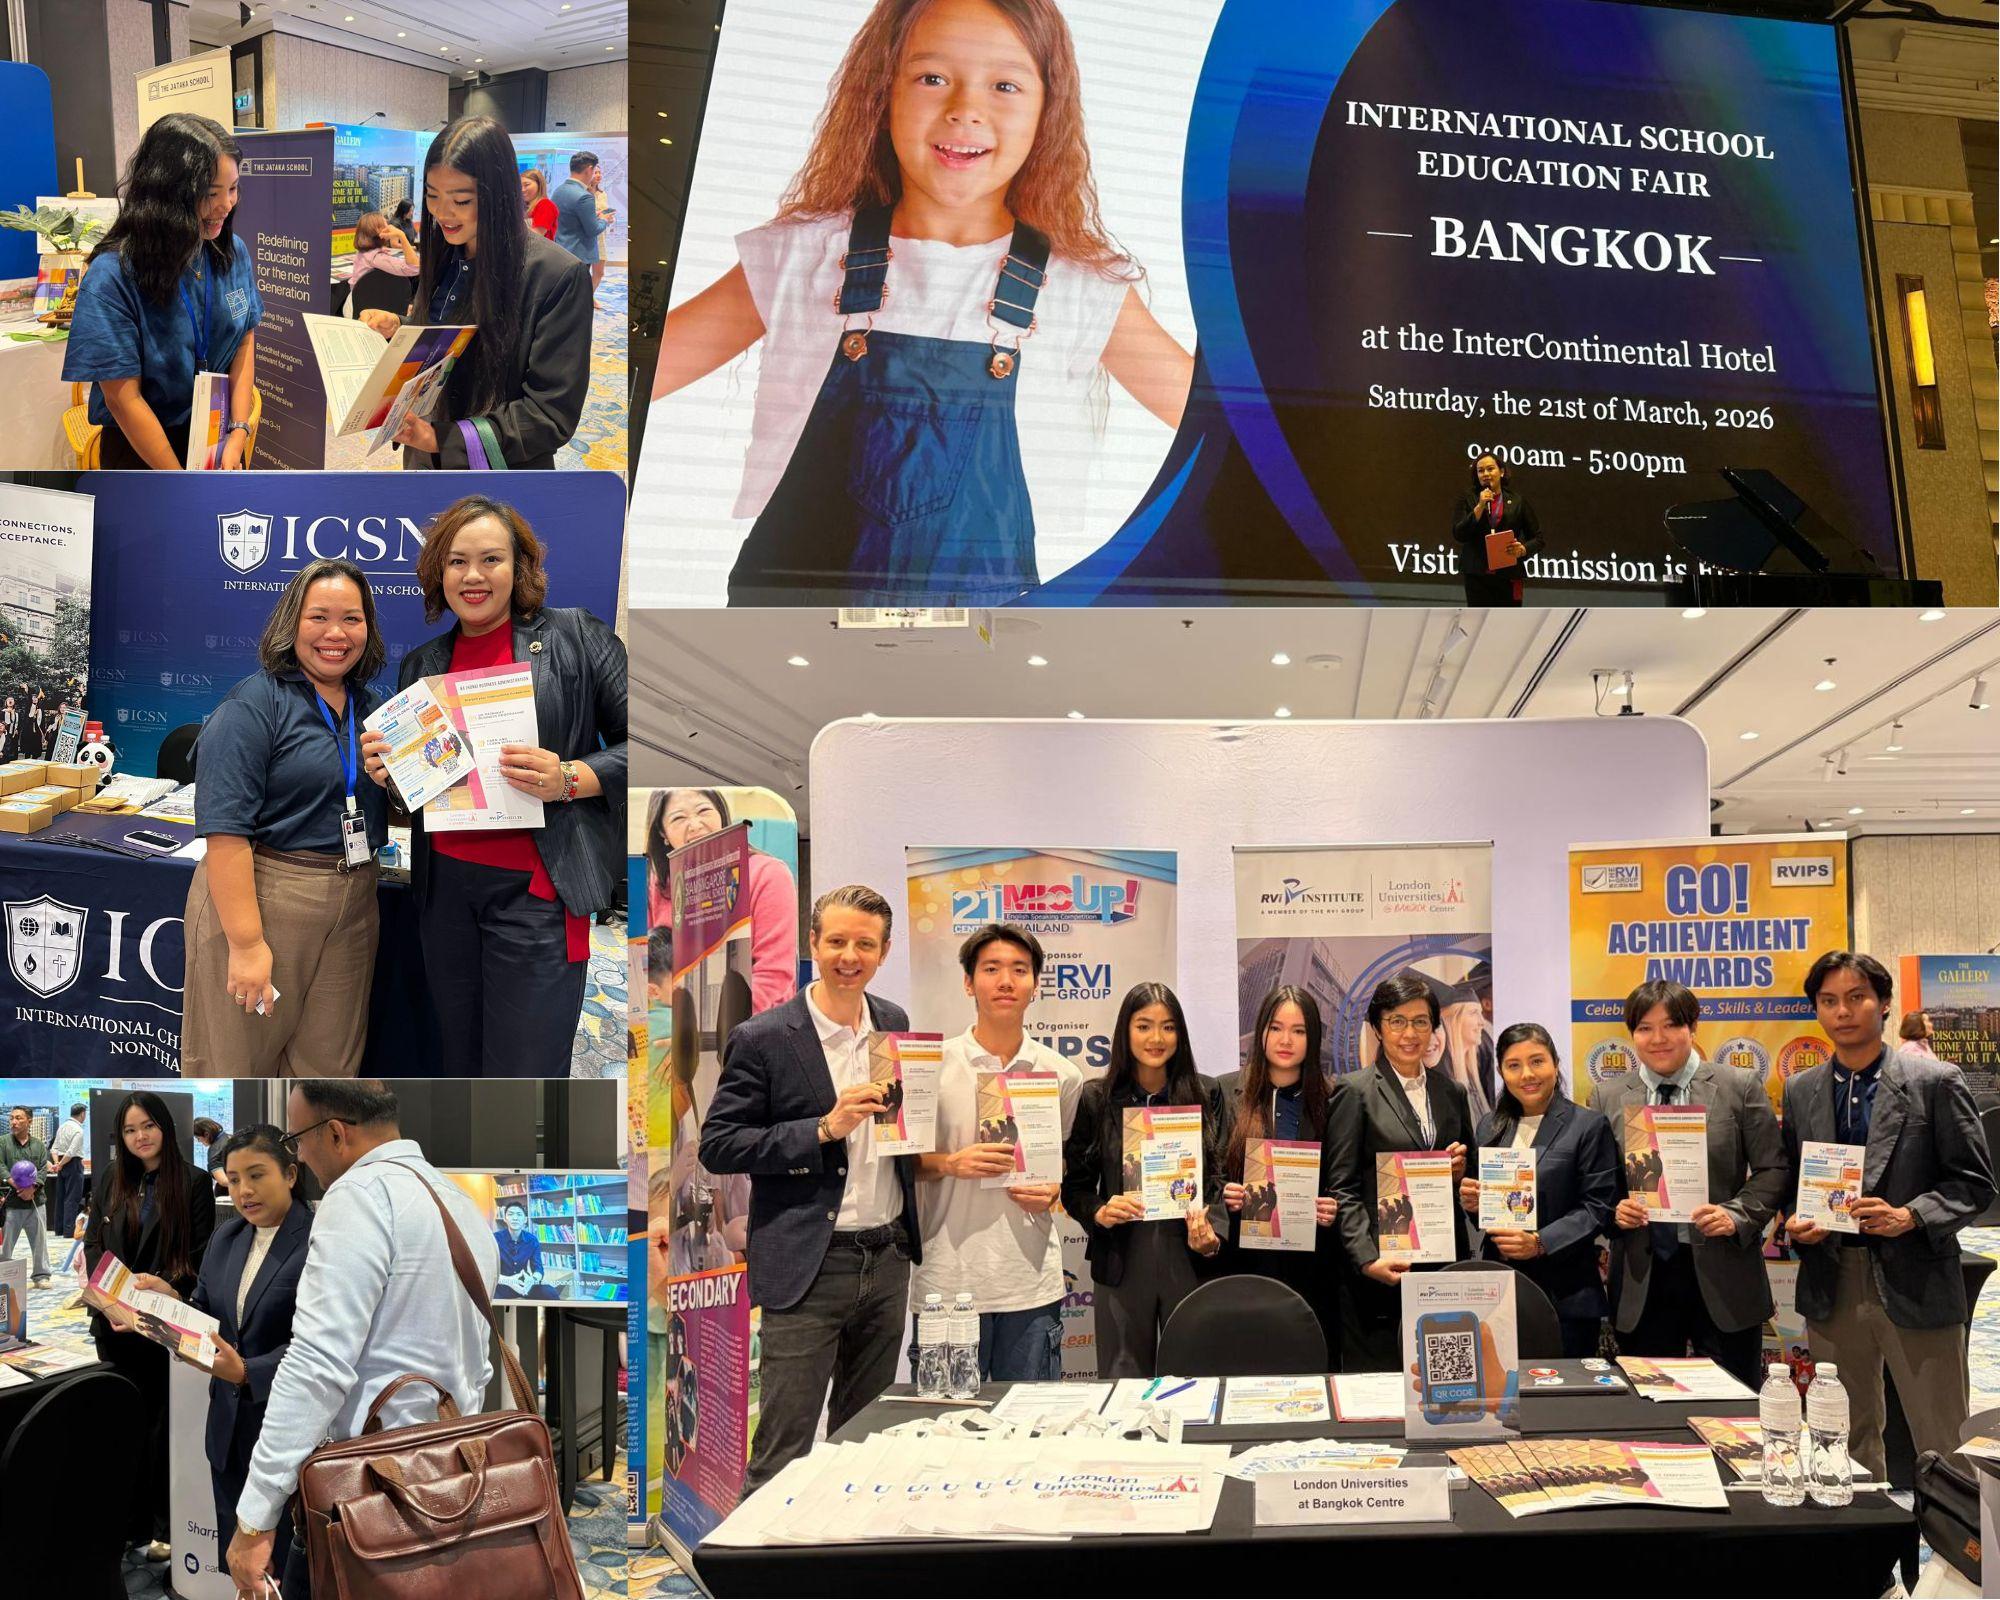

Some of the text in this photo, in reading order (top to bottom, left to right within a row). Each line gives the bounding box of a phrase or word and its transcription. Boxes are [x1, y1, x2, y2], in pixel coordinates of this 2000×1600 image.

[161, 75, 210, 93] THE JATAKA SCHOOL
[1346, 101, 1775, 159] INTERNATIONAL SCHOOL
[254, 163, 308, 172] THE JATAKA SCHOOL
[1417, 151, 1711, 197] EDUCATION FAIR
[257, 232, 309, 254] Redefining
[1430, 216, 1716, 275] BANGKOK
[257, 248, 305, 267] Education
[257, 264, 310, 285] for the next
[257, 279, 310, 302] Generation
[256, 342, 304, 367] Buddhist wisdom,
[1362, 323, 1776, 373] at the InterContinental Hotel
[255, 354, 278, 367] relevant
[278, 361, 286, 369] for
[256, 376, 284, 394] Inquiry-led
[267, 390, 294, 408] immersive
[1368, 384, 1774, 430] Saturday, the 21st of March, 2026
[260, 416, 270, 426] ges
[255, 446, 277, 465] Opening
[1589, 450, 1687, 478] 5:00pm
[0, 519, 76, 535] ONNECTIONS,
[0, 532, 67, 546] CCEPTANCE.
[1388, 544, 1458, 574] Visit
[1524, 550, 1657, 582] dmission
[176, 673, 212, 686] ICSN
[131, 709, 168, 723] ICSN
[1615, 866, 1639, 878] RVI
[1776, 864, 1829, 878] RVIPS
[1389, 881, 1431, 891] London
[1665, 862, 1751, 917] GO!
[1302, 892, 1364, 904] INSTITUTE
[1379, 891, 1442, 904] Universities
[1429, 905, 1456, 913] Centre
[1031, 914, 1059, 922] Speaking
[954, 924, 981, 933] CENT
[1608, 918, 1812, 954] ACHIEVEMENT
[1644, 955, 1774, 989] AWARDS
[1958, 962, 1970, 970] THE
[1040, 964, 1056, 1000] THE
[1058, 964, 1111, 988] RVI
[1938, 970, 1990, 984] GALLERY
[1058, 988, 1111, 1000] GROUP
[1717, 1002, 1750, 1014] Skills
[1754, 1002, 1764, 1012] &
[16, 1006, 154, 1037] INTERNATIONAL
[1037, 1022, 1090, 1031] Organiser
[1932, 1030, 1989, 1041] DISCOVER A
[1933, 1042, 1998, 1052] HOME AT THE
[110, 1041, 181, 1073] NONTHA
[1603, 1054, 1626, 1069] GO!
[1730, 1053, 1754, 1067] GO!
[1967, 1053, 1978, 1063] OF
[1982, 1053, 1991, 1063] IT
[585, 1279, 605, 1287] world
[1435, 1389, 1473, 1399] QR CODE
[1059, 1475, 1139, 1484] London
[1294, 1477, 1408, 1490] London Universities
[1033, 1481, 1157, 1493] Universities
[1129, 1493, 1180, 1501] Centre
[1298, 1497, 1405, 1511] at Bangkok Centre
